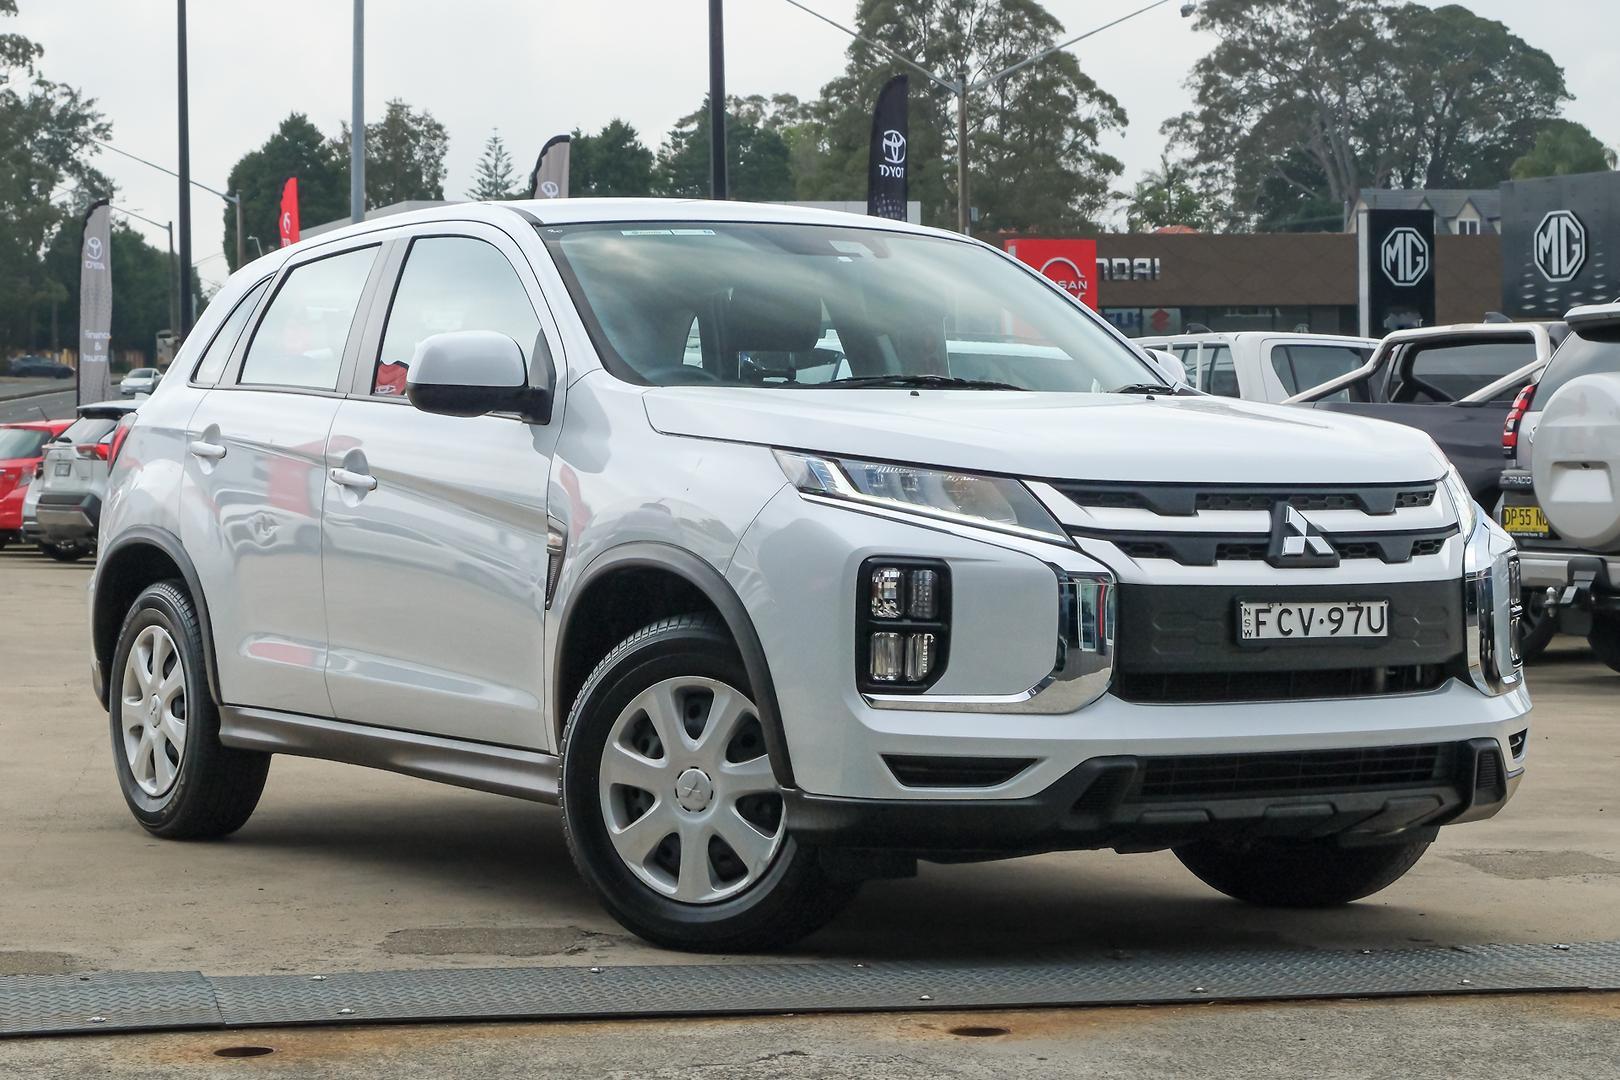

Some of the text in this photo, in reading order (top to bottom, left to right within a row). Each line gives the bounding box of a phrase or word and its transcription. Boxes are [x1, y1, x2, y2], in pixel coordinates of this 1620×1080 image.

[878, 164, 904, 178] TOYOT
[1386, 233, 1424, 281] MG
[1538, 216, 1581, 276] MG
